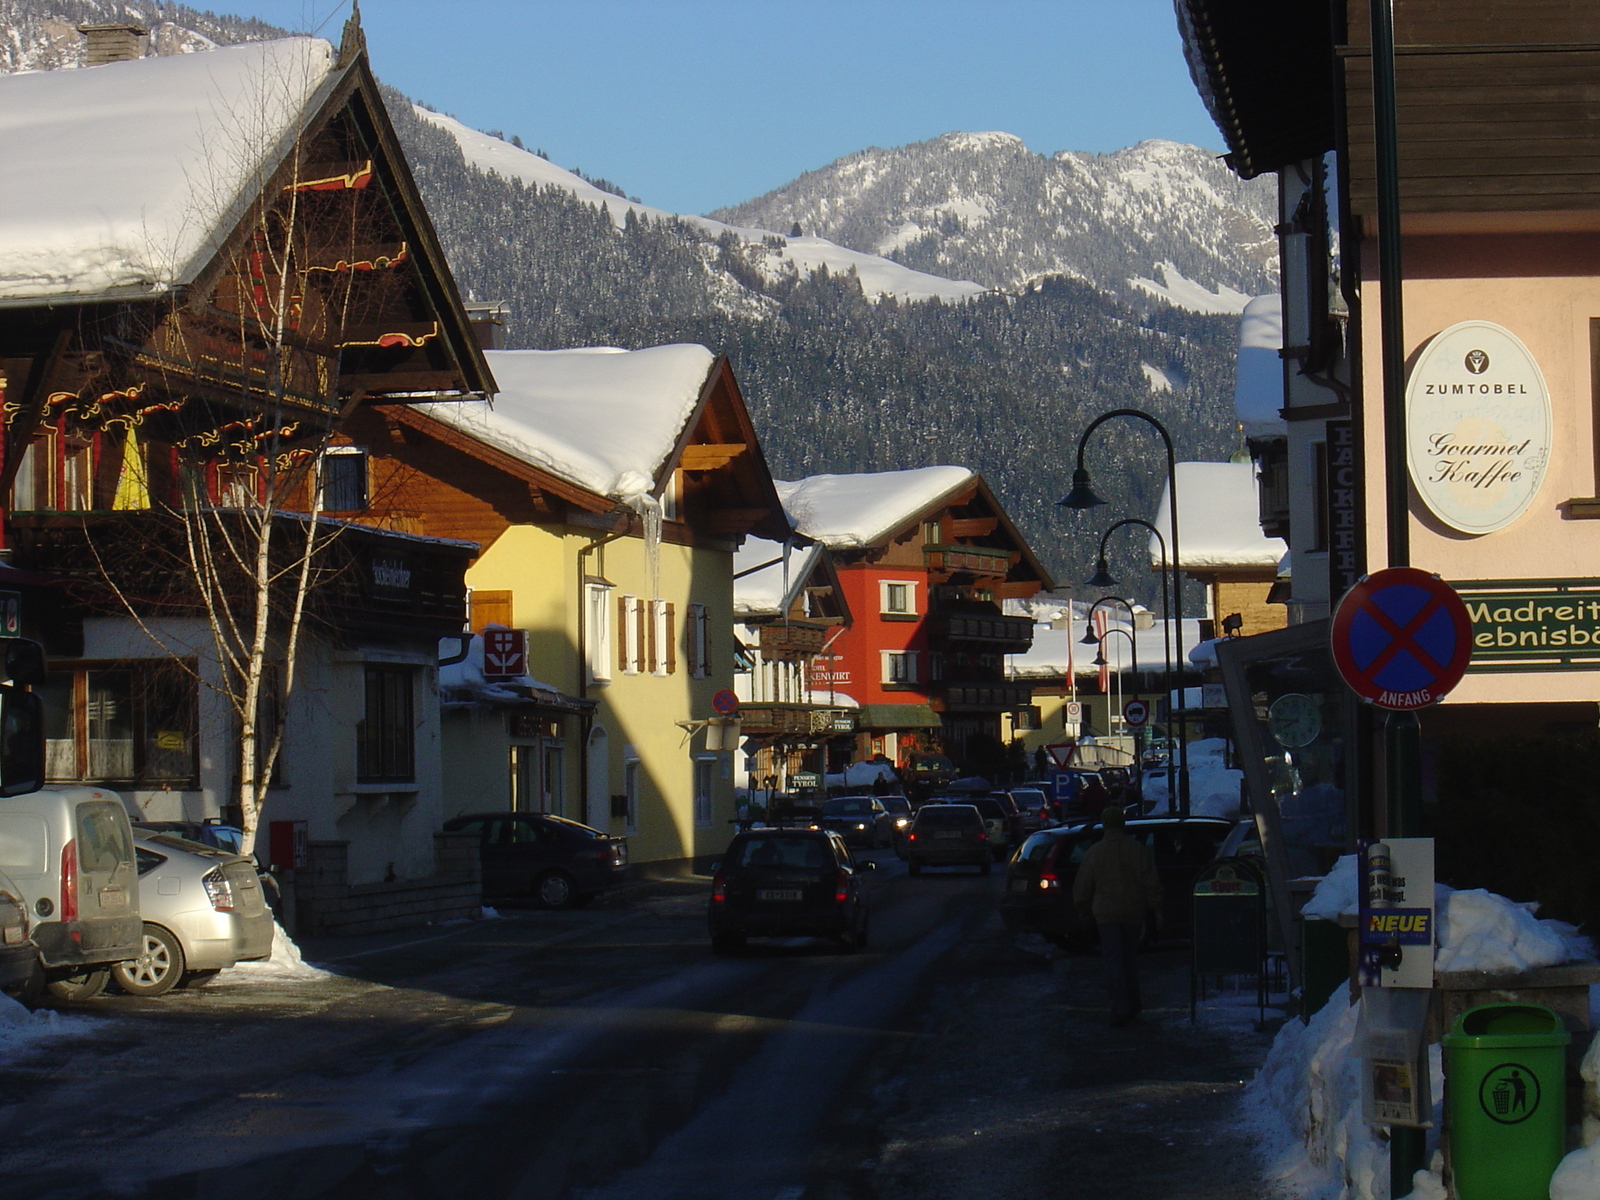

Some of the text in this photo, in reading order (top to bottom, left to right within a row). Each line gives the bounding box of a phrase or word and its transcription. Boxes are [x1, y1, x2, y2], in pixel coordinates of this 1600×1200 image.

[1425, 384, 1527, 395] ZUMTOBEL
[1427, 433, 1531, 456] Gourmet
[1428, 460, 1522, 488] Kaffee
[1378, 689, 1431, 706] ANFANG
[792, 780, 819, 788] TYROL
[1056, 774, 1070, 793] P
[1369, 915, 1428, 932] NEUE
